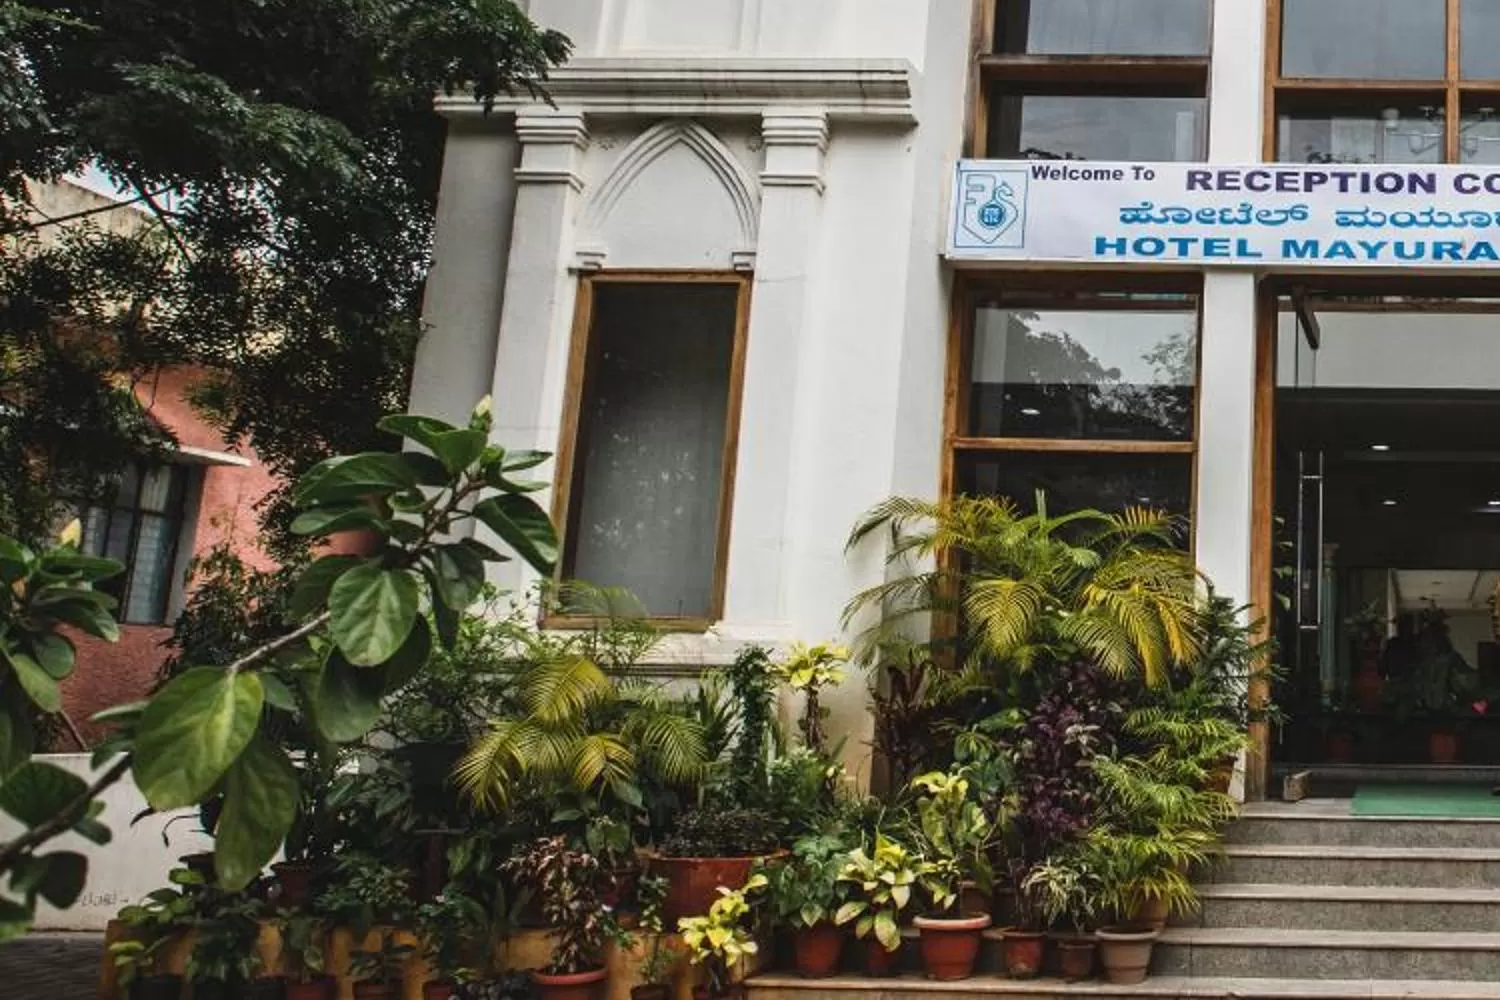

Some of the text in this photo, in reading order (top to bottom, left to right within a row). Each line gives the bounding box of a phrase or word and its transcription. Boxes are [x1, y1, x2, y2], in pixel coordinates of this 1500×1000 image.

[1032, 165, 1155, 181] Welcome To
[1185, 170, 1437, 194] RECEPTION
[1119, 201, 1309, 226] ಹೋಟೆಲ್
[1095, 237, 1263, 258] HOTEL
[1281, 239, 1500, 261] MAYURA
